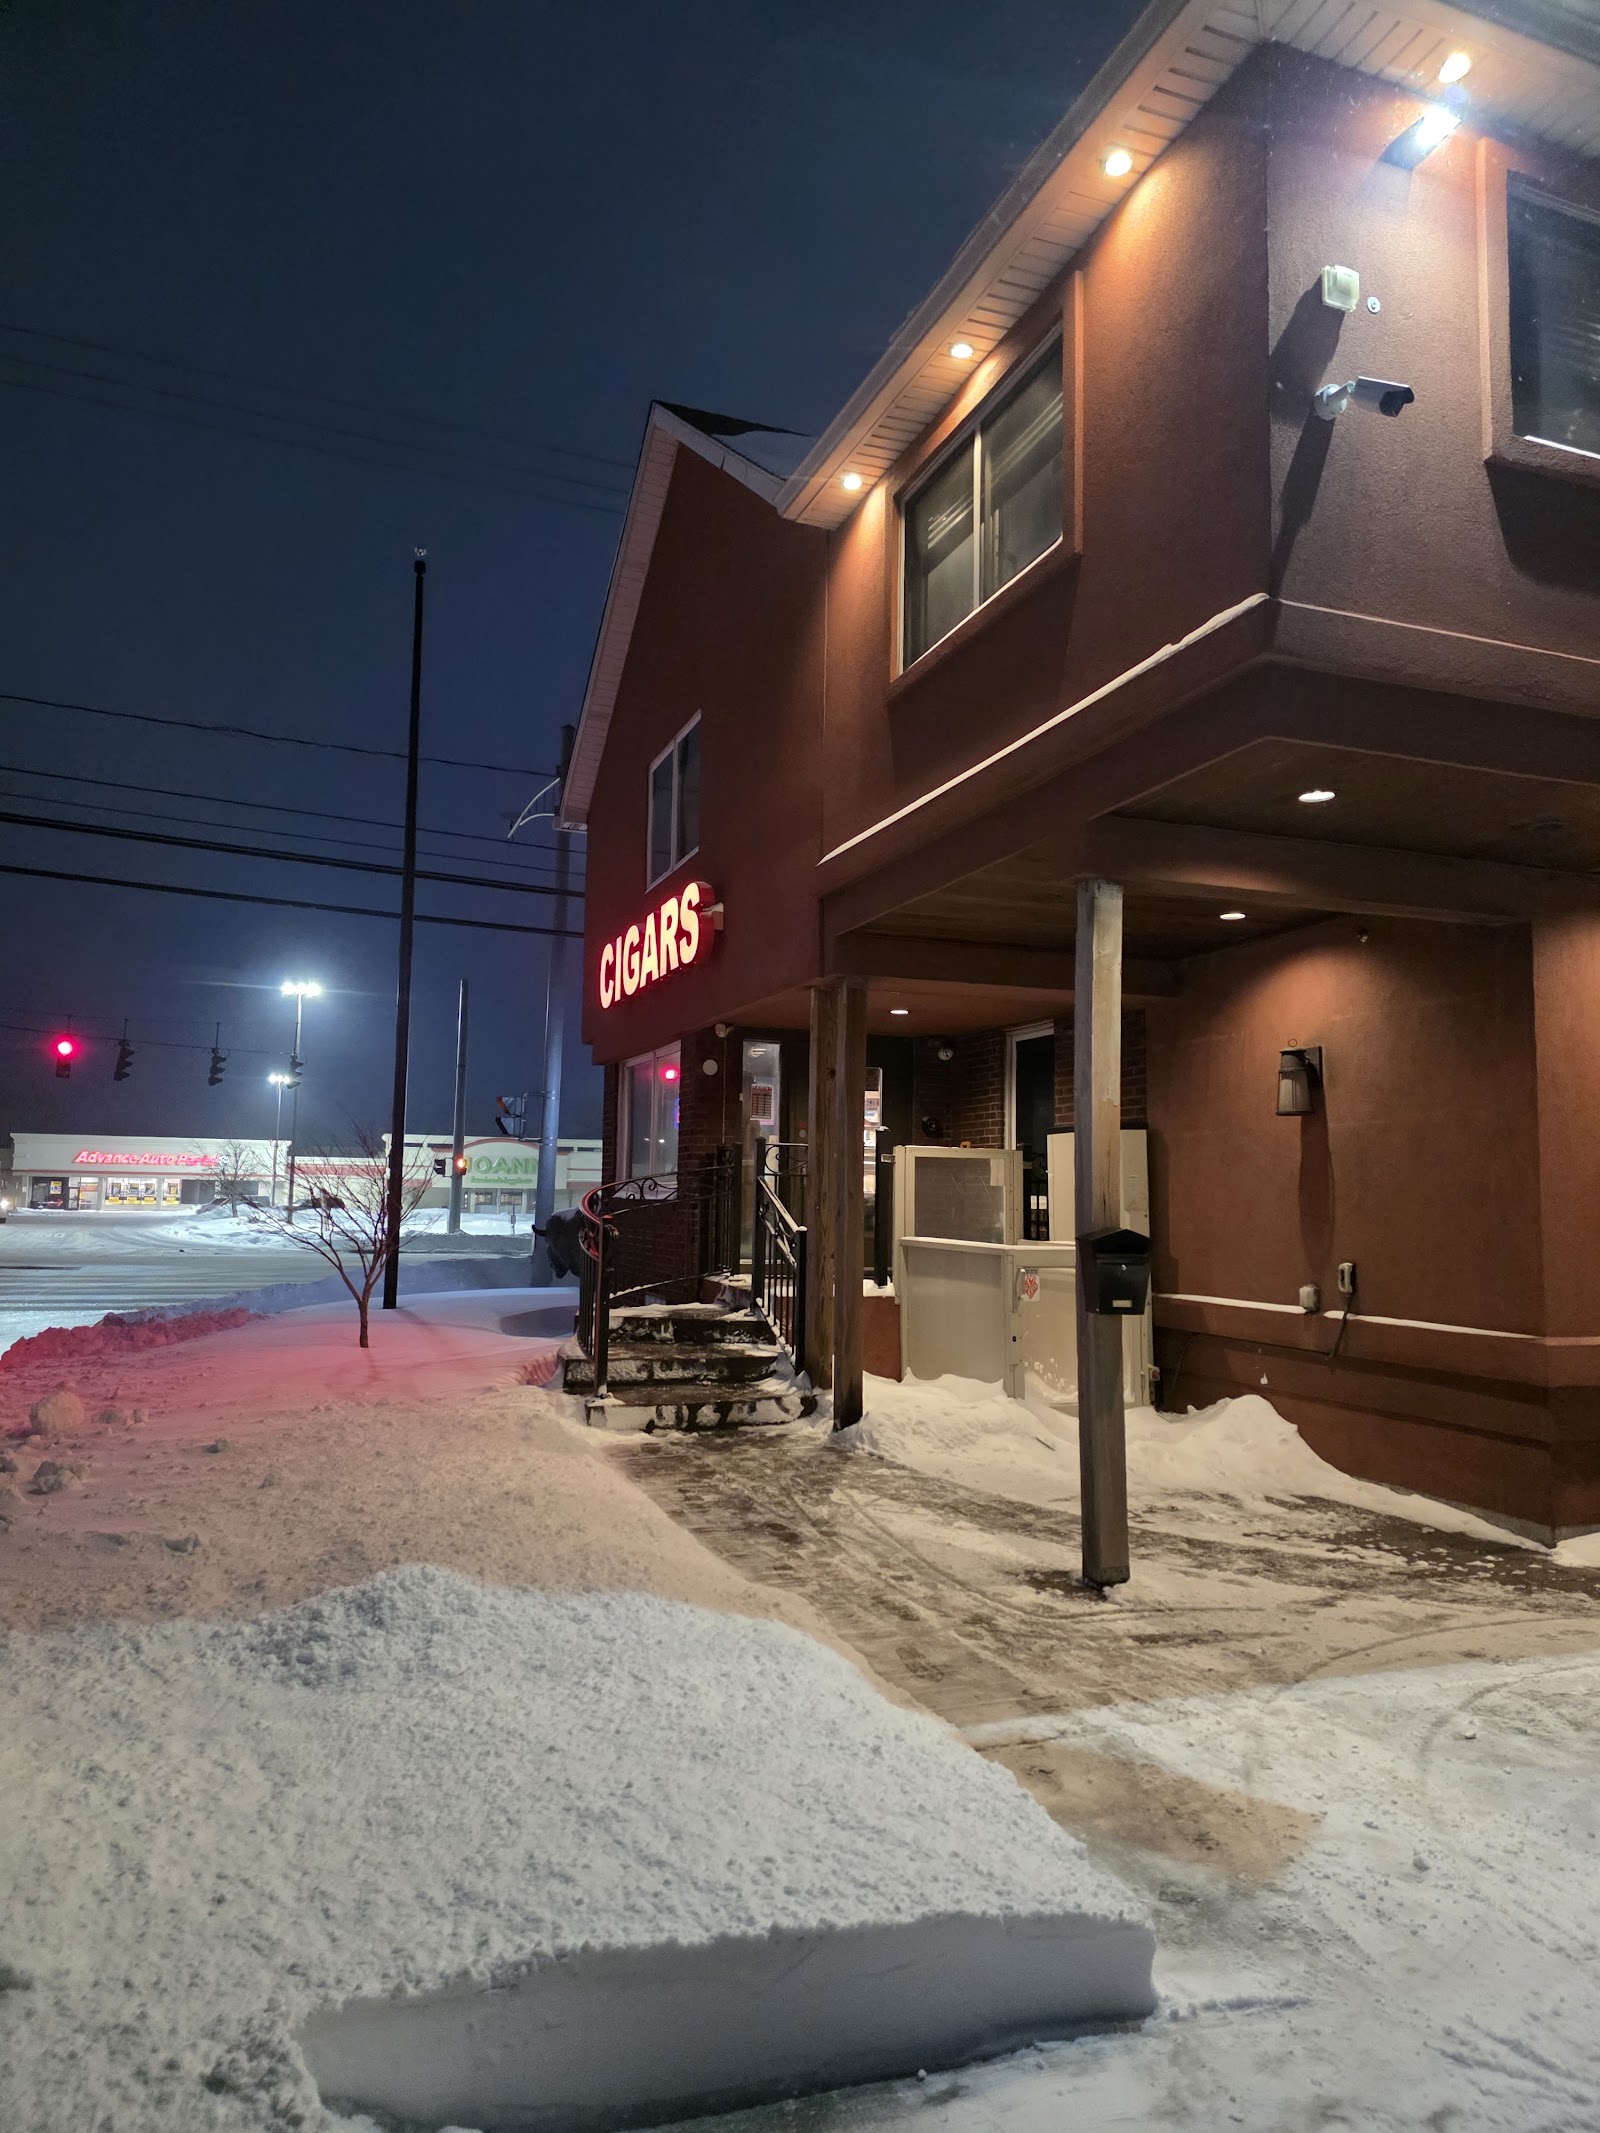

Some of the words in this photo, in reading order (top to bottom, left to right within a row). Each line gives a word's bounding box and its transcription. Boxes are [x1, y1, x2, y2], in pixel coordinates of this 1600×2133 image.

[599, 881, 700, 1009] CIGARS
[75, 1150, 137, 1164] Advance
[138, 1152, 175, 1165] Auto
